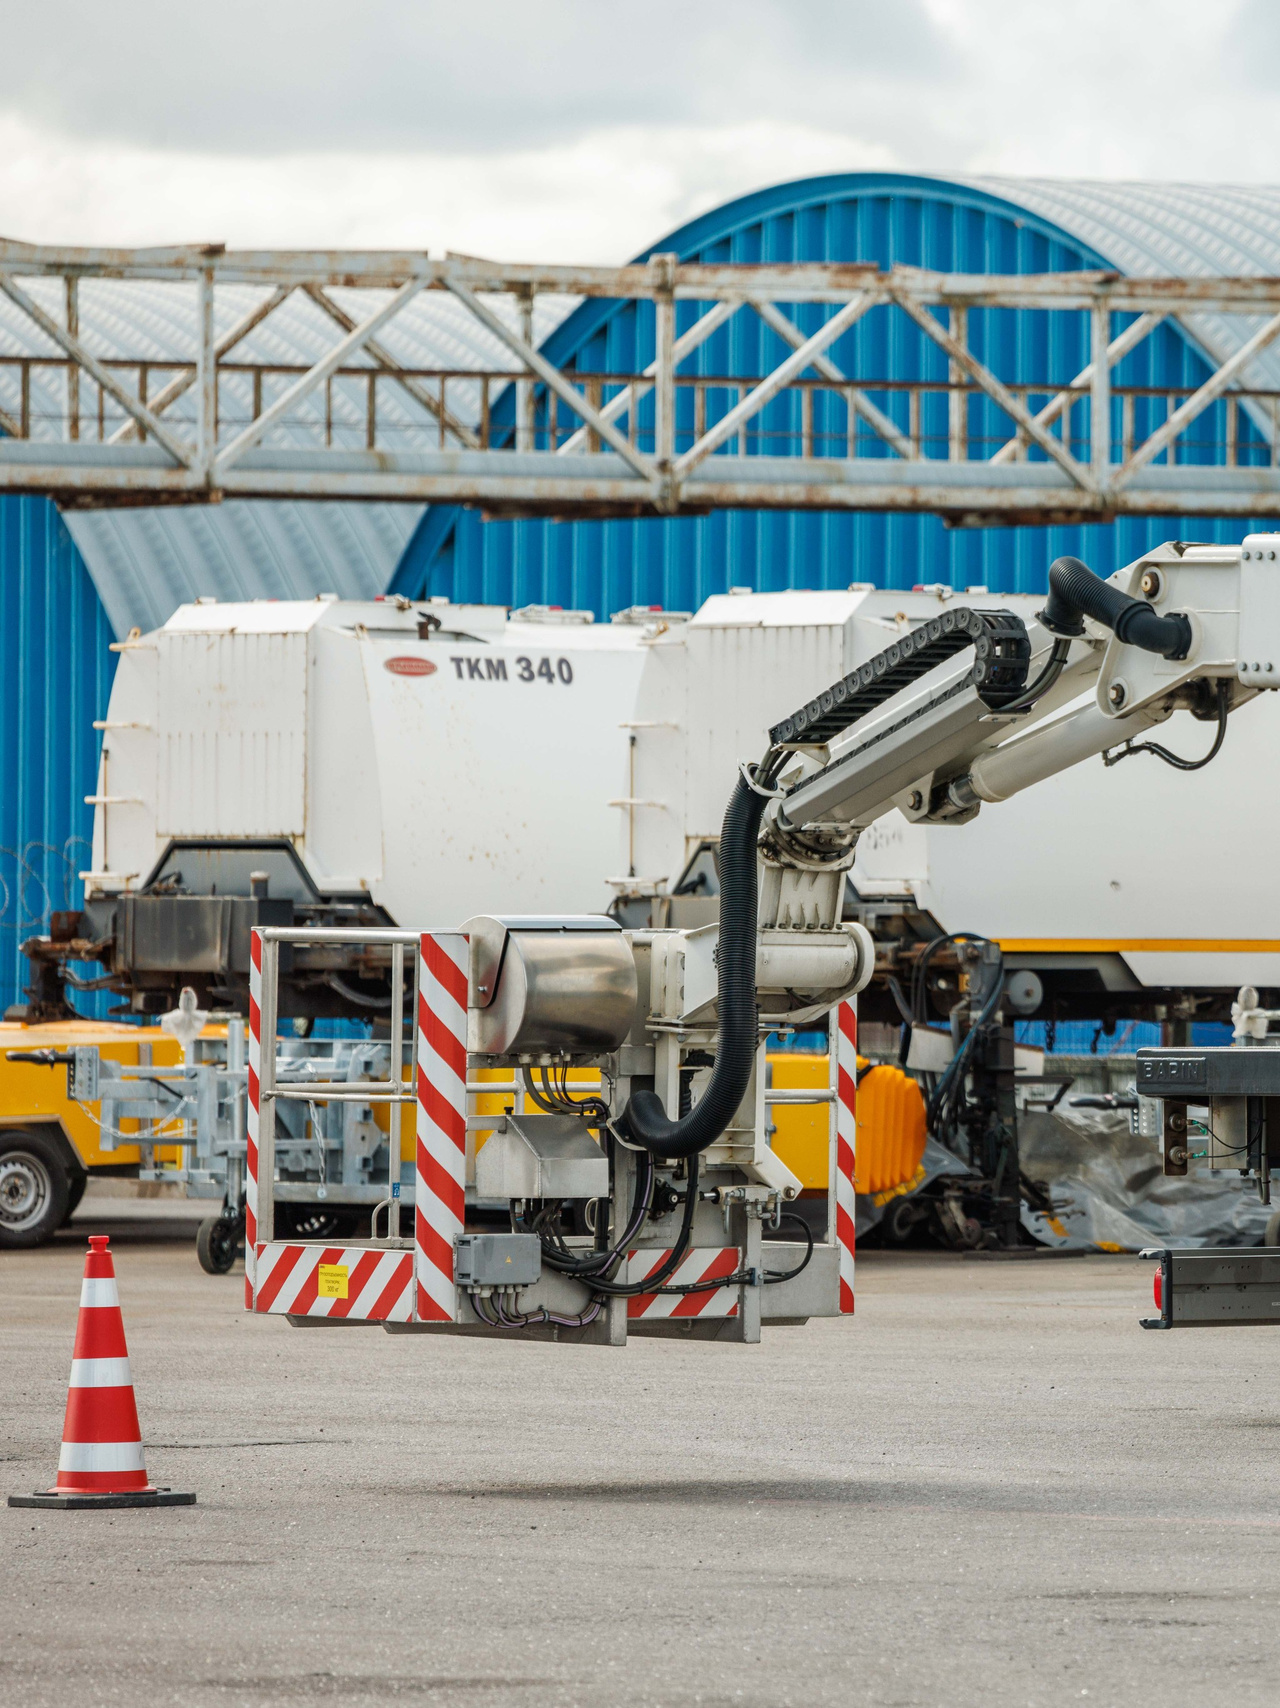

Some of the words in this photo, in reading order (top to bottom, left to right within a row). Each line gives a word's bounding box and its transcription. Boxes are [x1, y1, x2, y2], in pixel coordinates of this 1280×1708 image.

[450, 657, 508, 681] TKM
[516, 657, 573, 684] 340
[1144, 1062, 1199, 1080] BARIN
